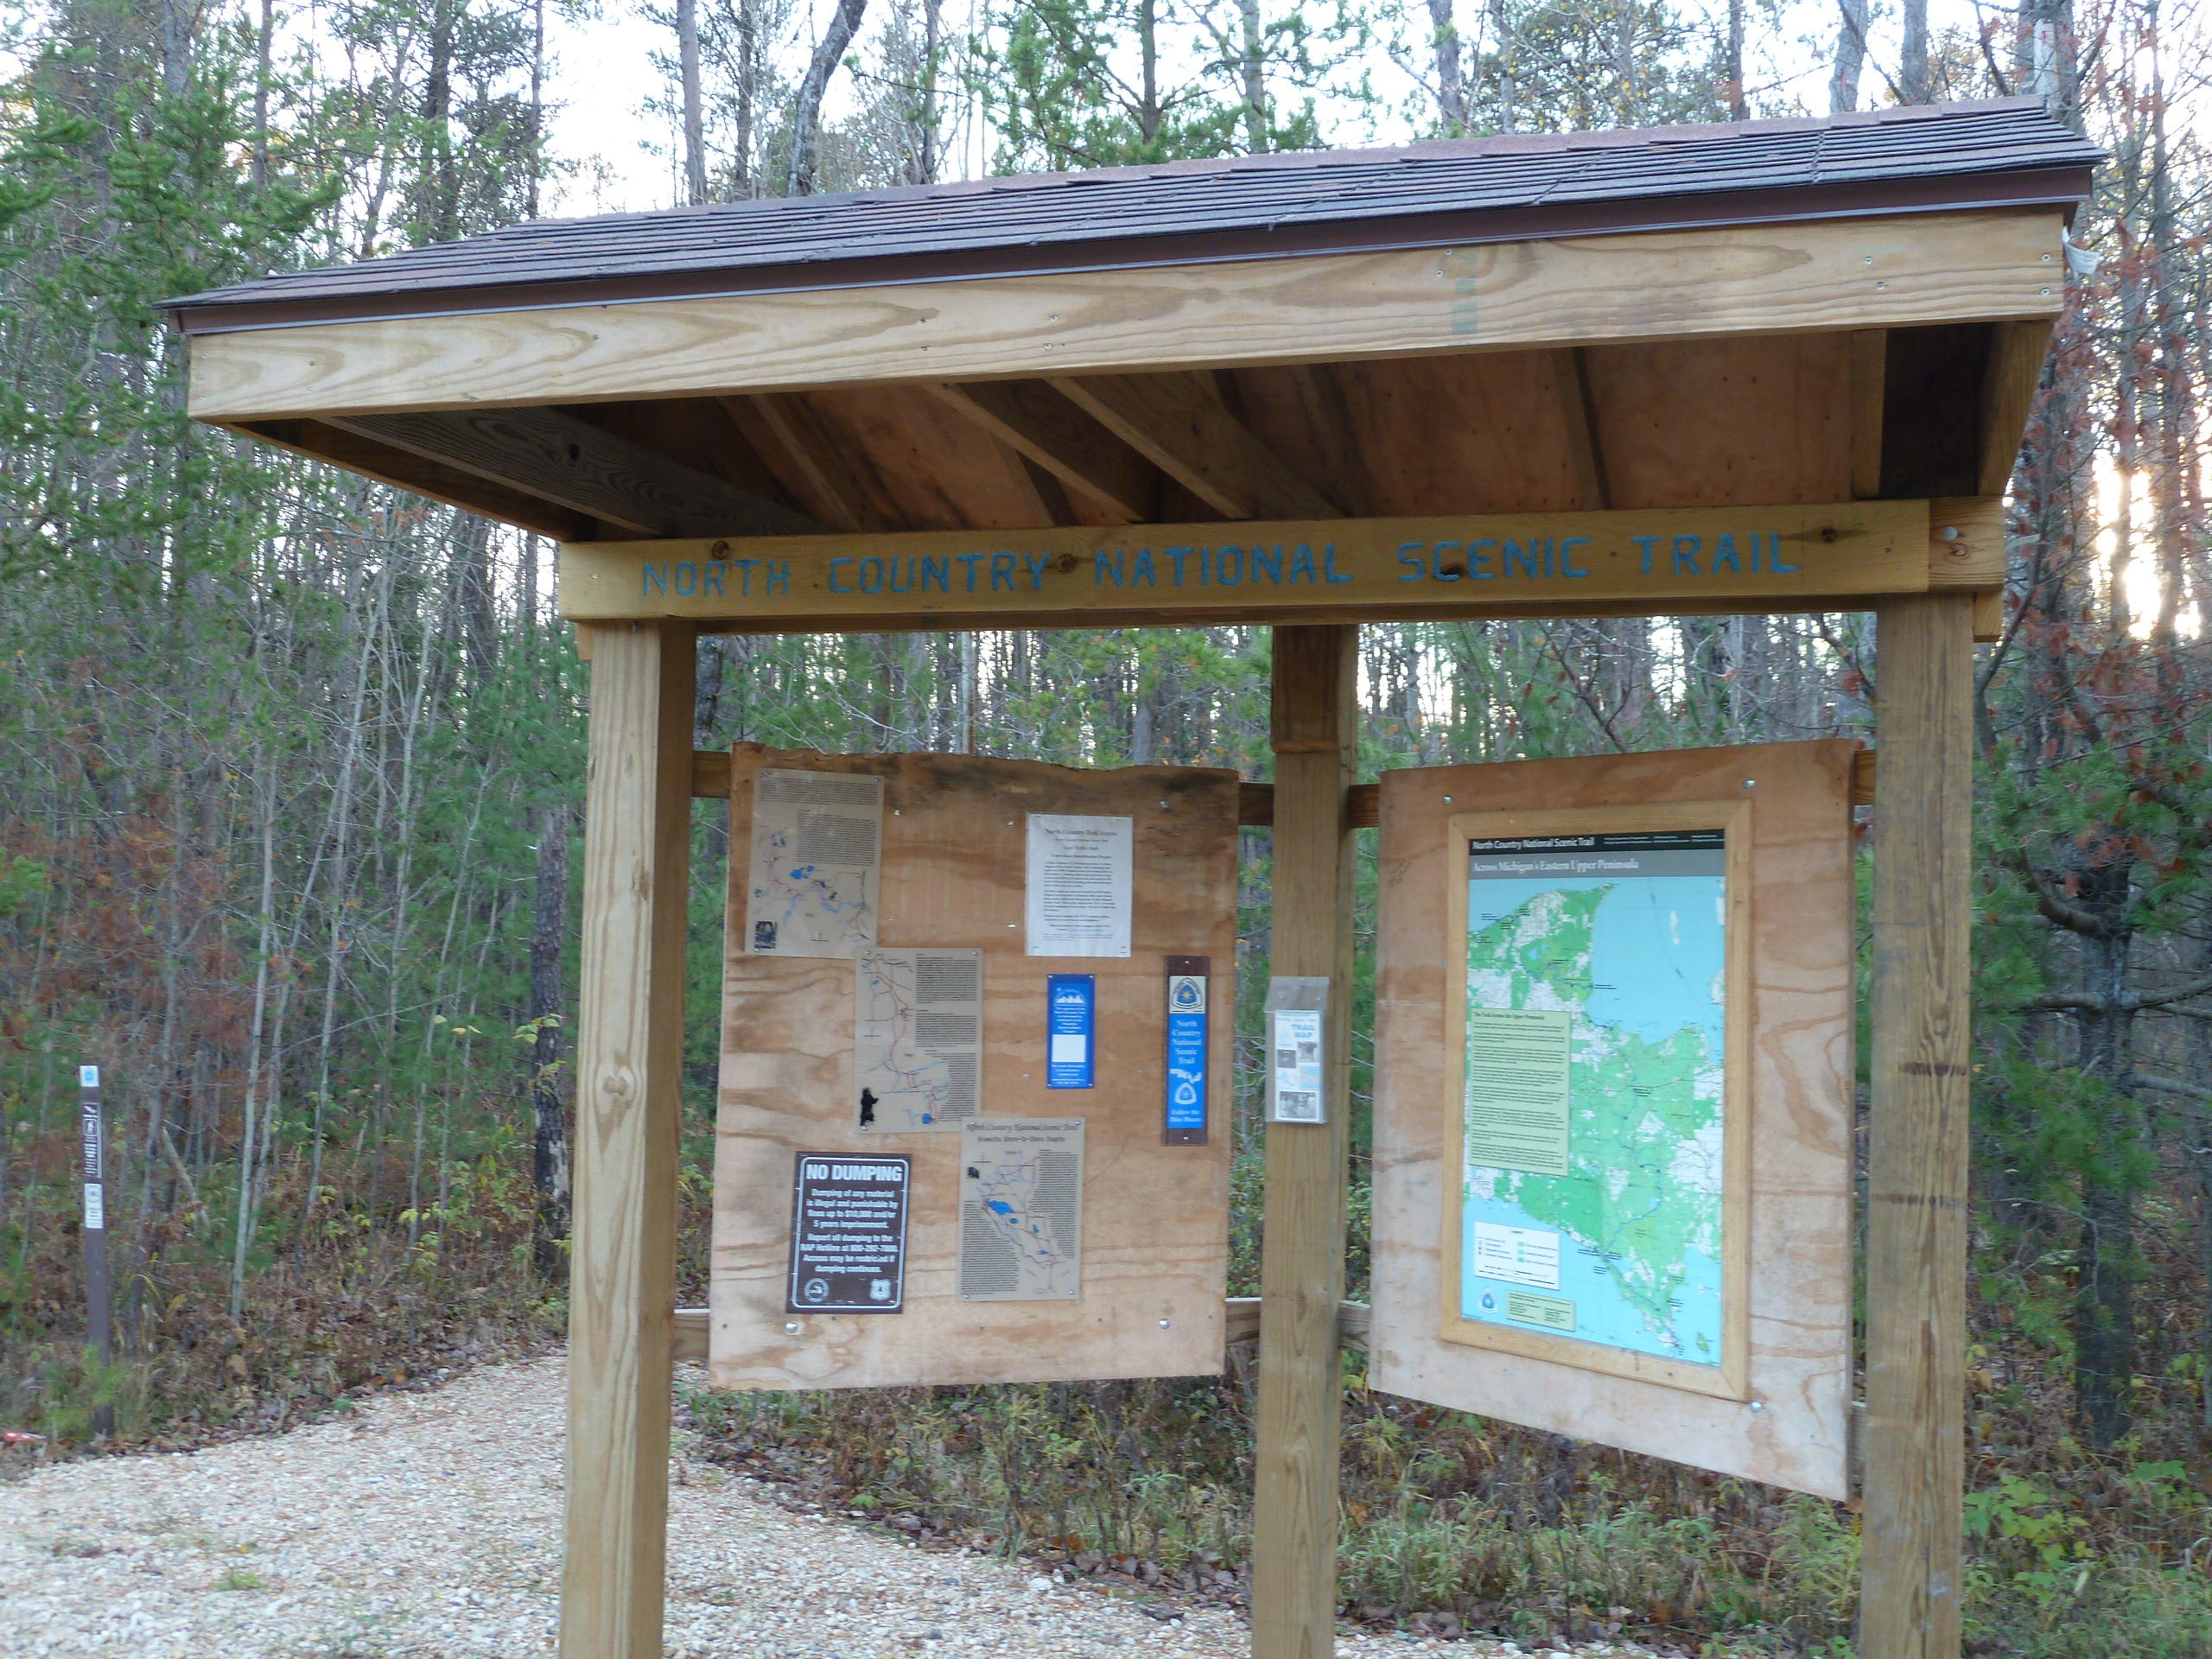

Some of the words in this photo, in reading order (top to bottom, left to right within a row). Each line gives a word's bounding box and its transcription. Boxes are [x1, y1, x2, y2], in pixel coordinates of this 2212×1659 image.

[642, 557, 790, 597] NORTH
[829, 551, 1052, 595] COUNTRY
[1095, 543, 1352, 588] NATIONAL
[1397, 535, 1592, 583] SCENIC
[1631, 531, 1800, 576] TRAIL
[1472, 840, 1493, 849] North
[1494, 840, 1522, 850] Country
[1522, 838, 1554, 848] National
[1554, 837, 1578, 847] Scenic
[1579, 836, 1595, 846] Trail
[1499, 860, 1540, 874] Michigan's
[1540, 860, 1570, 870] Eastern
[1571, 860, 1597, 873] Upper
[1597, 857, 1638, 869] Peninsula
[806, 1164, 830, 1179] NO
[831, 1165, 903, 1182] DUMPING
[811, 1188, 843, 1198] Dumping
[852, 1191, 865, 1199] any
[814, 1198, 836, 1208] illegal
[850, 1199, 888, 1209] punishable
[889, 1200, 899, 1210] by
[826, 1211, 836, 1219] up
[807, 1233, 831, 1242] Report
[831, 1233, 842, 1242] all
[842, 1234, 872, 1243] dumping
[815, 1264, 845, 1274] dumping
